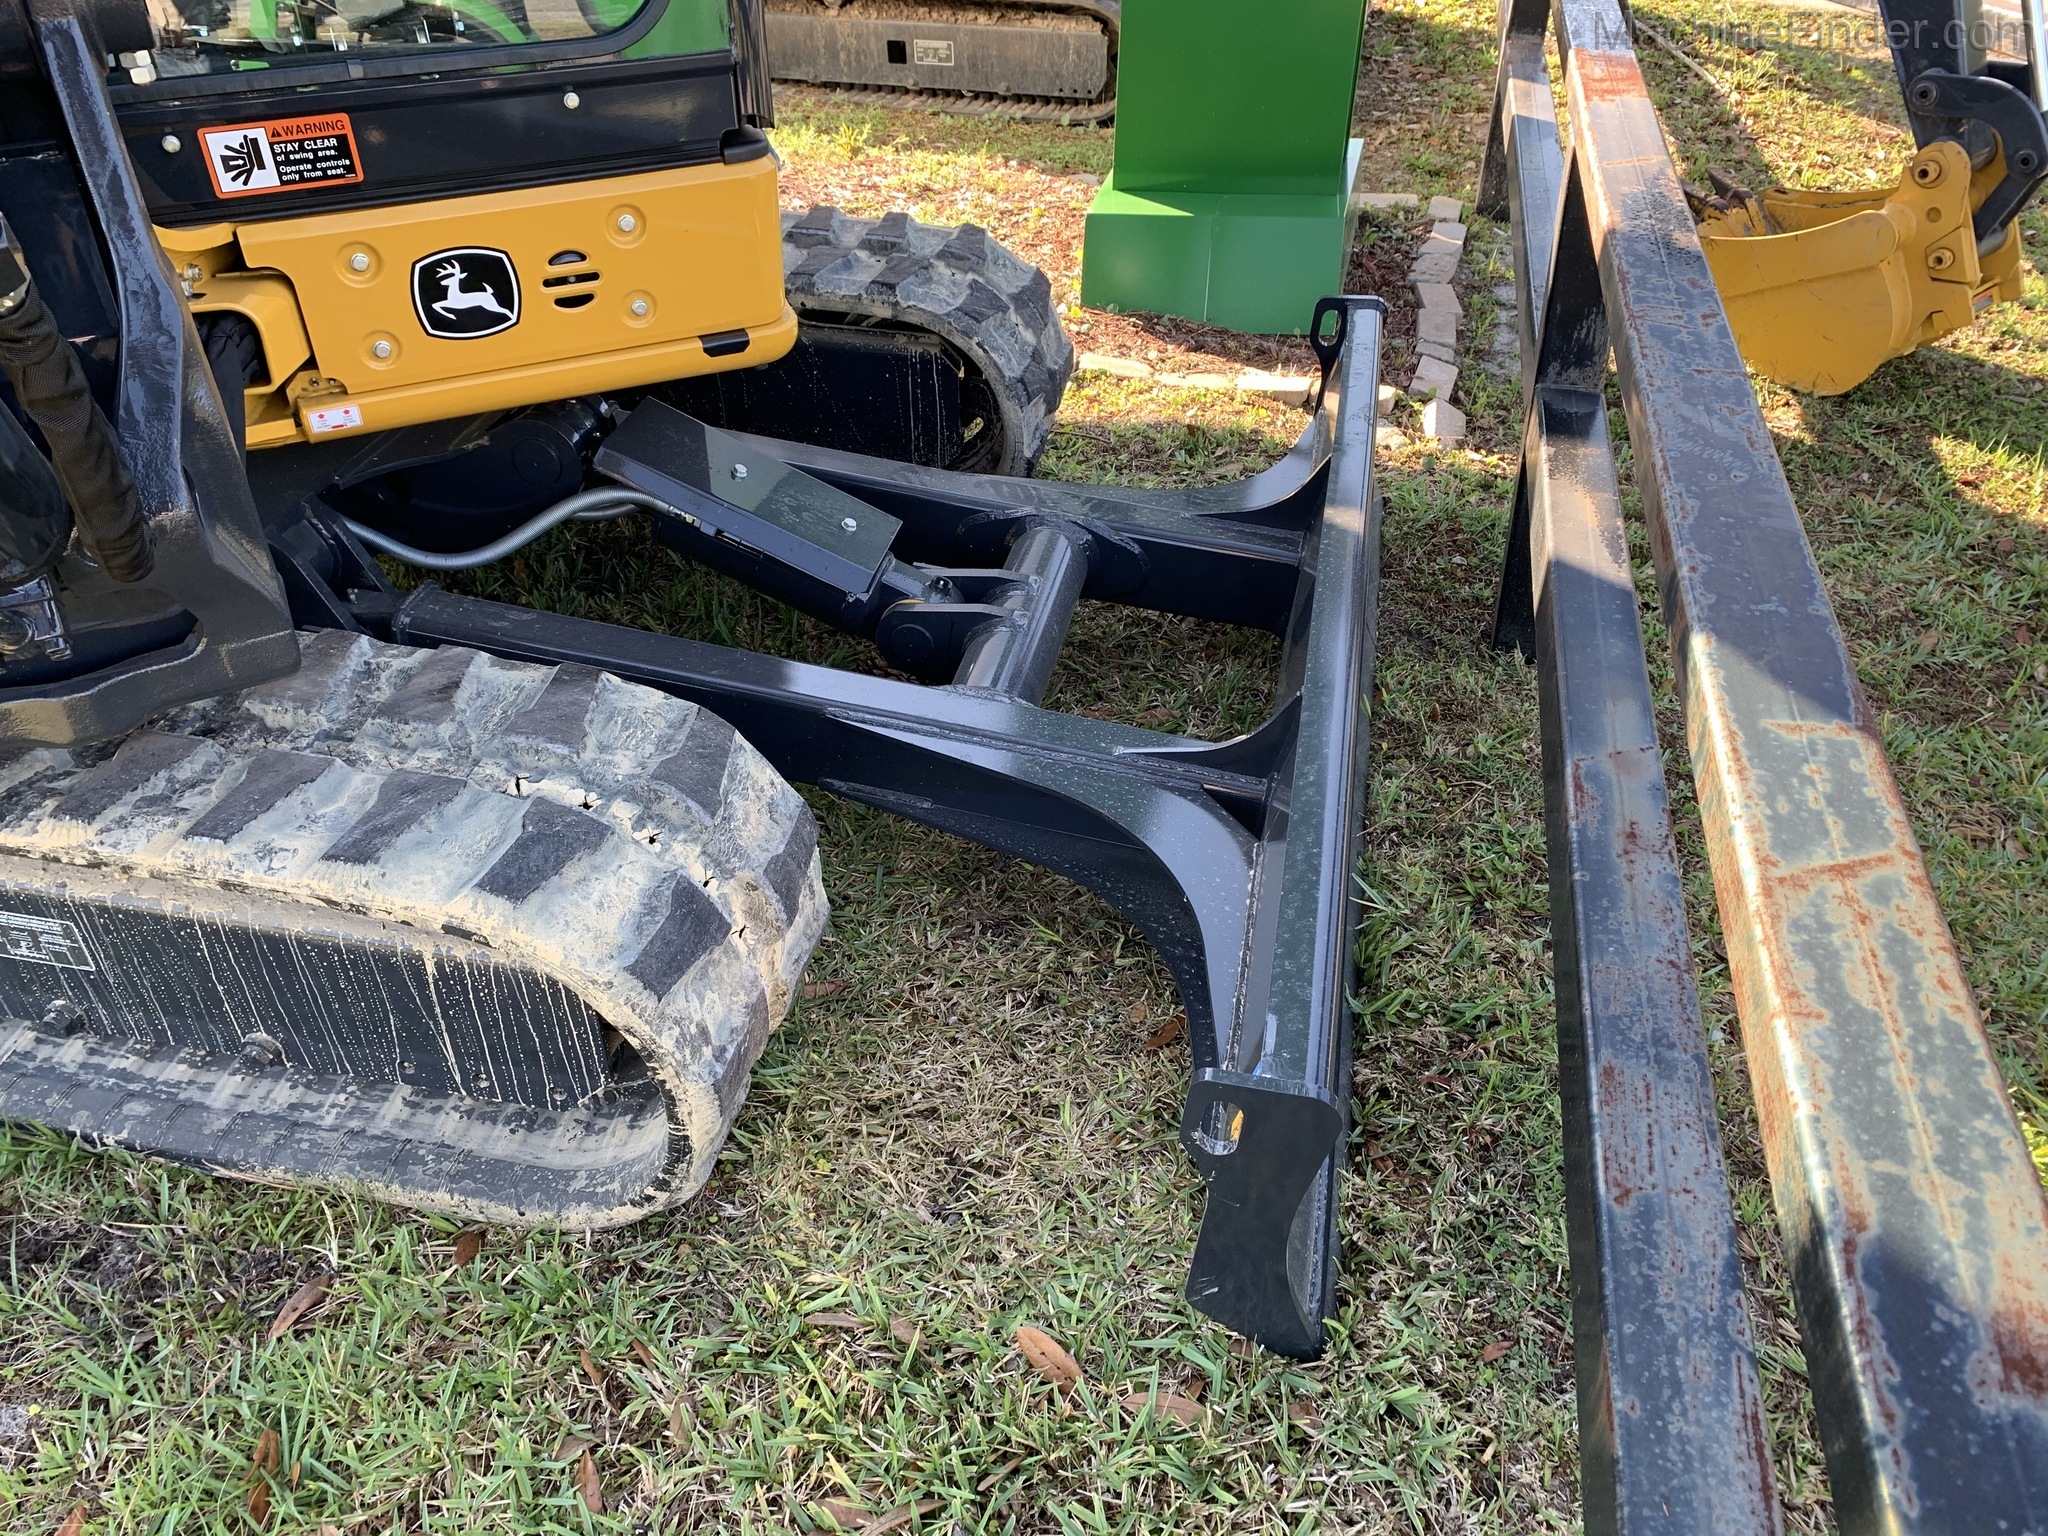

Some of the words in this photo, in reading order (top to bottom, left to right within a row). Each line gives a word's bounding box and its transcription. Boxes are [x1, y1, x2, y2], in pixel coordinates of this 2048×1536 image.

[282, 120, 345, 136] WARNING
[273, 142, 299, 153] STAY
[304, 138, 337, 149] CLEAR
[289, 152, 313, 160] swing
[279, 163, 312, 173] Operate
[316, 159, 350, 168] controls
[282, 173, 299, 181] only
